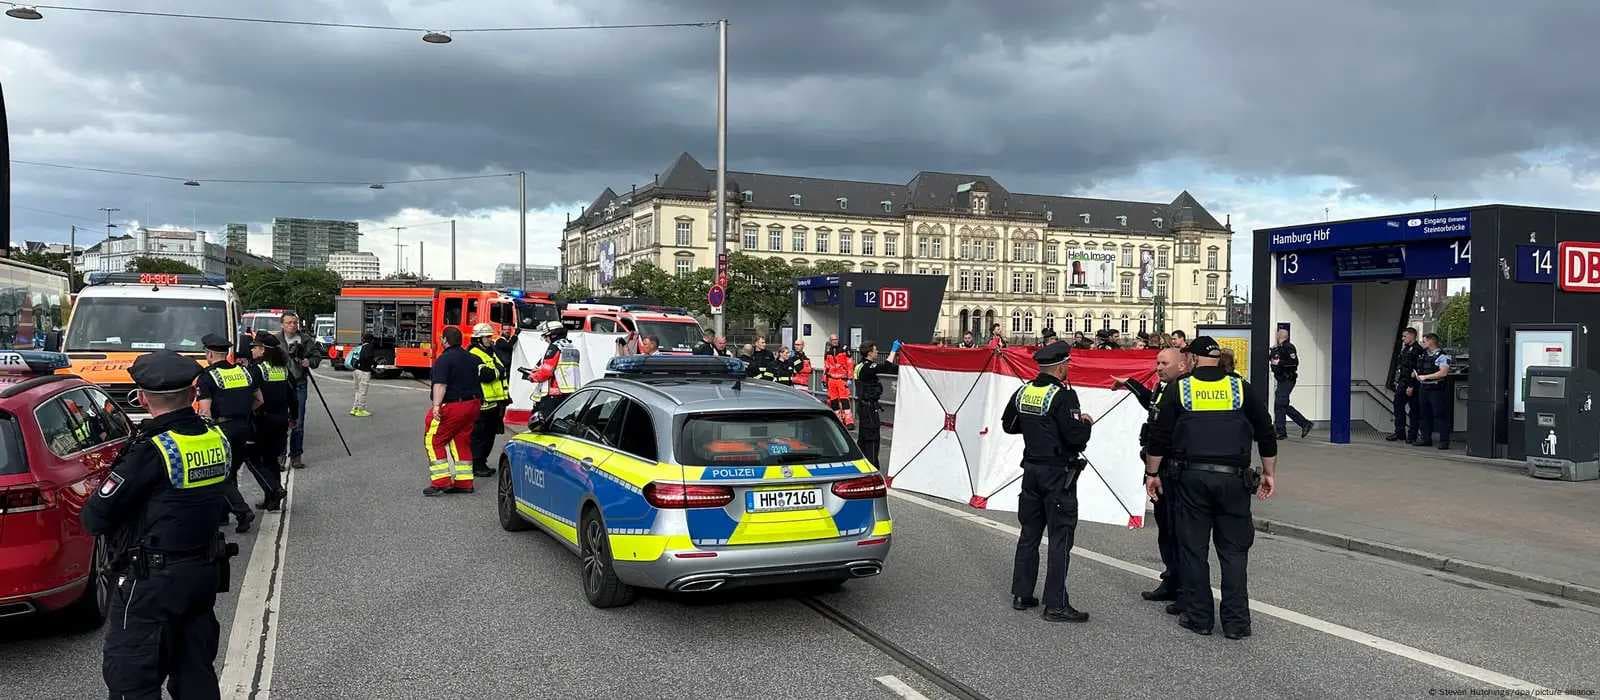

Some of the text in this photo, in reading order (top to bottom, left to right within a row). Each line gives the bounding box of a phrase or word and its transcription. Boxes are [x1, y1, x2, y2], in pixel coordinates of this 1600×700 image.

[1273, 228, 1331, 245] Hamburg Hbf
[1424, 224, 1466, 234] Steintorbrücke
[1068, 250, 1116, 264] Hello Image
[1450, 240, 1472, 265] 14
[1281, 253, 1299, 275] 13
[1532, 249, 1553, 275] 14
[1568, 250, 1600, 284] DB
[864, 291, 876, 303] 12
[884, 291, 906, 307] DB
[1195, 390, 1228, 400] POLIZEI
[186, 447, 224, 467] POLIZEI
[525, 464, 545, 489] POLIZEI
[712, 468, 755, 478] POLIZEI
[760, 491, 816, 507] HH 7160
